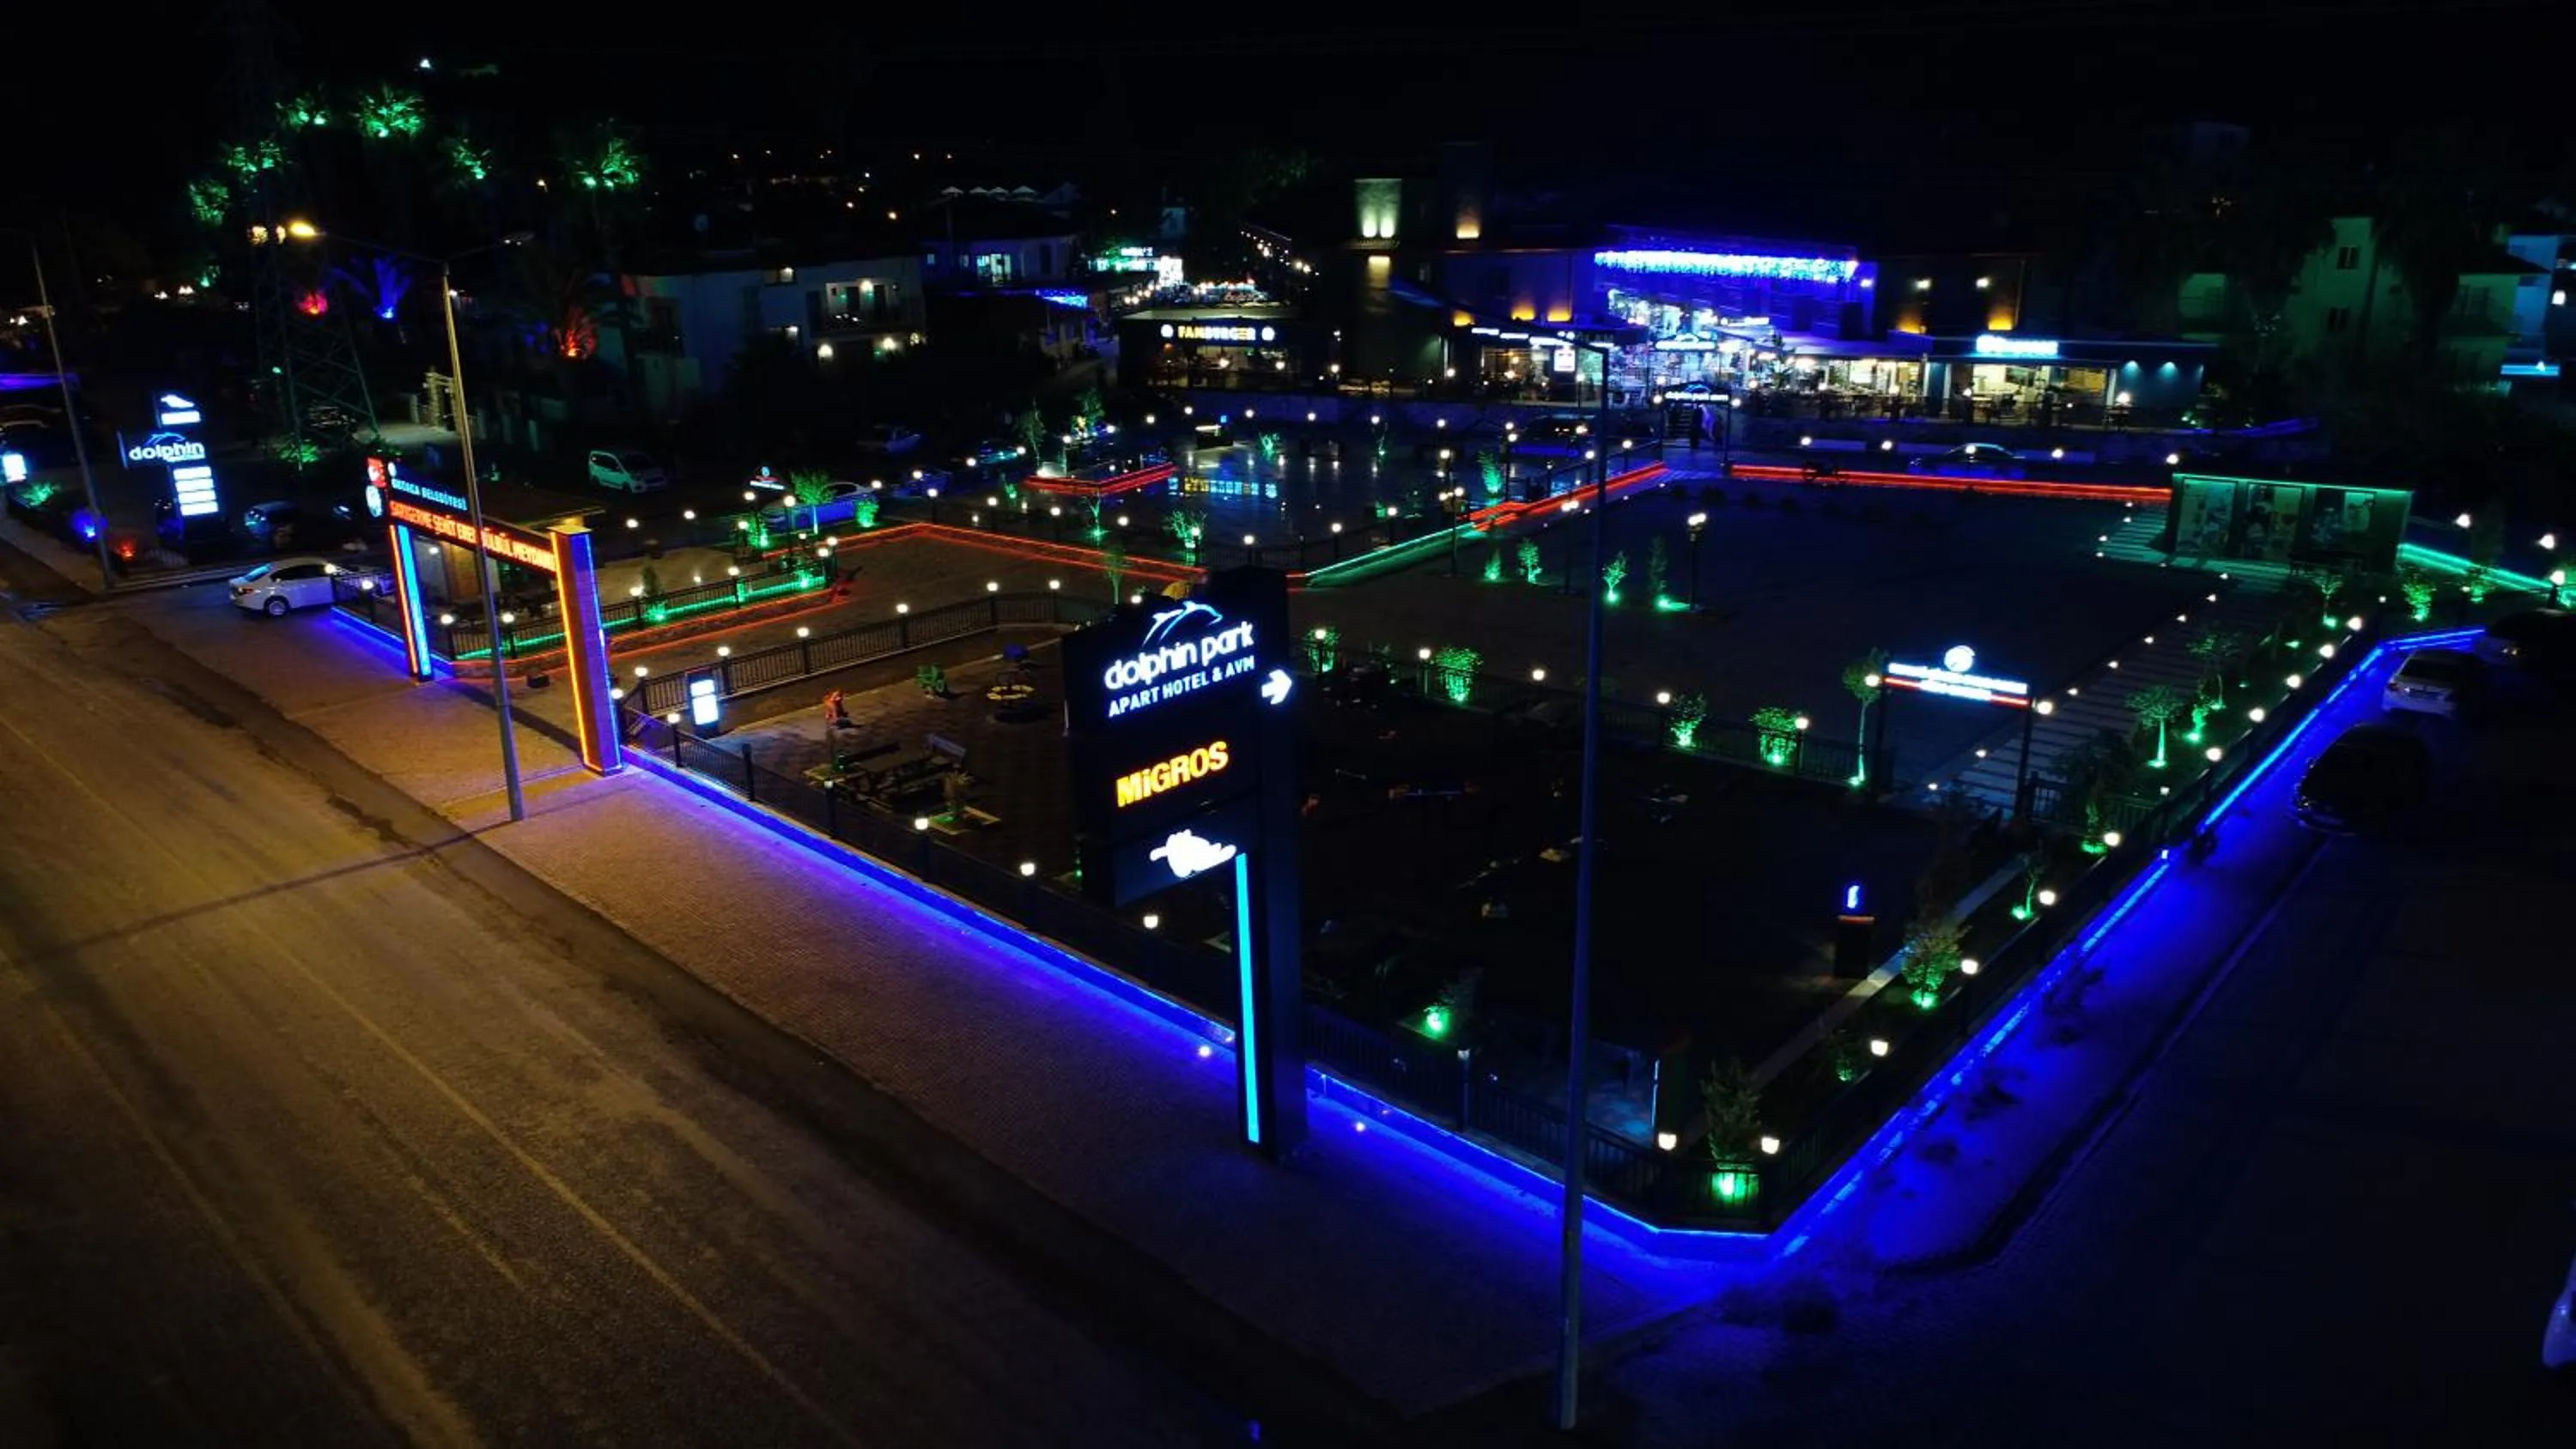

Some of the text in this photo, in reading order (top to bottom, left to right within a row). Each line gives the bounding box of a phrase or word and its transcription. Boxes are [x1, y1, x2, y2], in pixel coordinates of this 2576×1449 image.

[129, 441, 205, 461] dolphin
[1104, 621, 1254, 689] dolphin park
[1109, 656, 1255, 717] APART HOTEL & AVM
